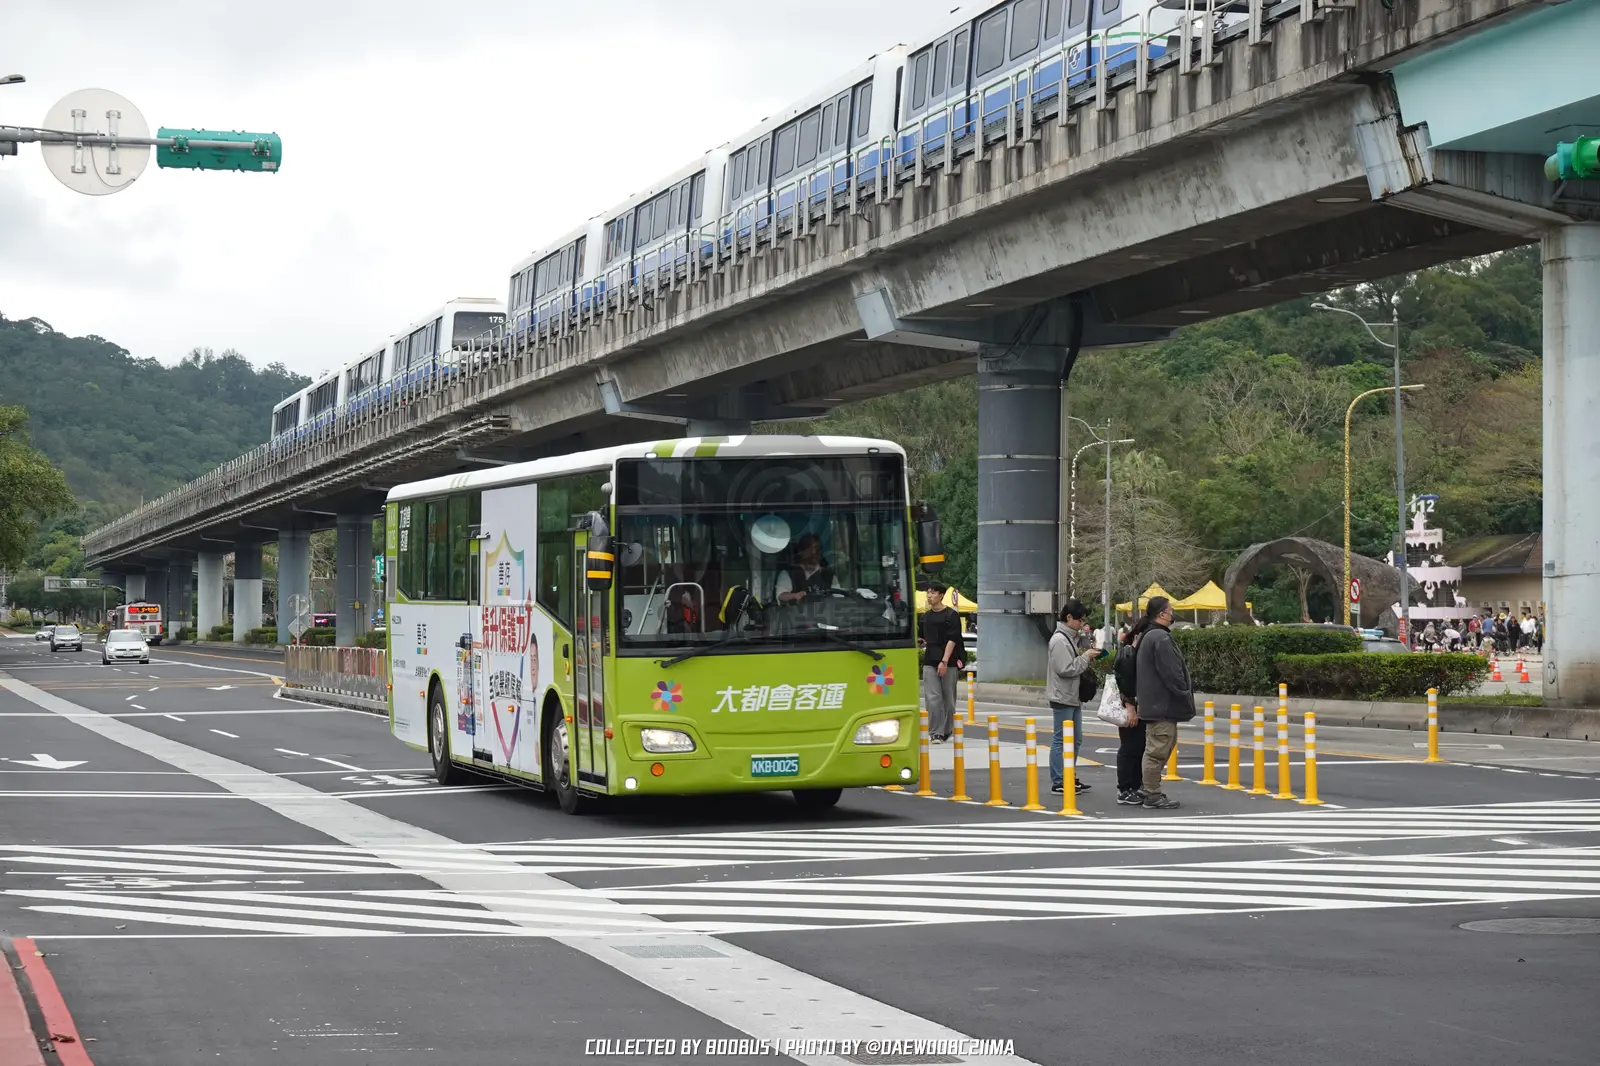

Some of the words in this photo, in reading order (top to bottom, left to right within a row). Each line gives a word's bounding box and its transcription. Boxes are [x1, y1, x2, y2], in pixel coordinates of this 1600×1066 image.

[488, 316, 504, 324] 175
[711, 682, 848, 713] 大都會客運
[751, 759, 799, 774] KKB-0025
